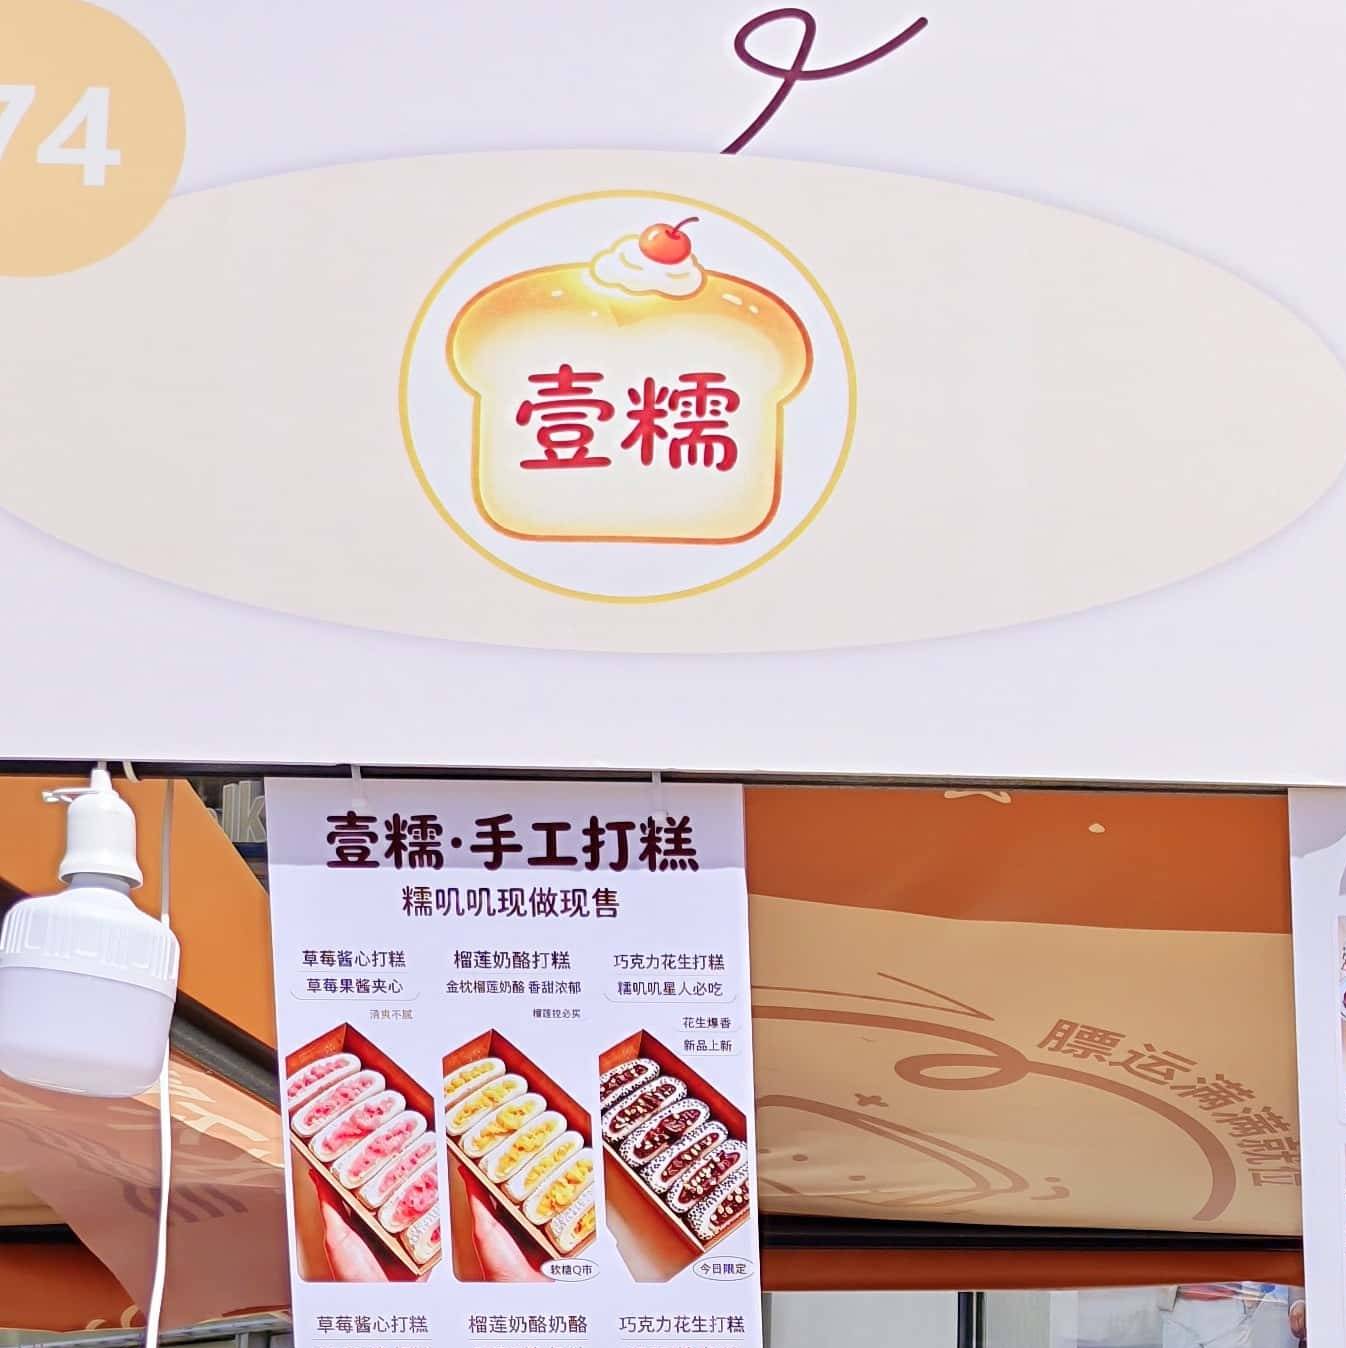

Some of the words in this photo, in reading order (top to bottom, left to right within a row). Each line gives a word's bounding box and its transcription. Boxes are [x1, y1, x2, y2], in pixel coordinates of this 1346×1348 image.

[515, 364, 741, 472] 壹糯
[326, 811, 699, 872] 壹糯·手工打糕
[401, 886, 621, 919] 糯叽叽现做现售
[301, 950, 406, 969] 草莓酱心打糕
[454, 950, 571, 970] 榴莲奶酪打糕
[613, 953, 725, 971] 巧克力花生打糕
[306, 978, 404, 994] 草莓果酱夹心
[618, 981, 723, 997] 糯叽叽星人必吃
[683, 1016, 732, 1030] 花生爆香
[684, 1039, 732, 1052] 新品上新
[700, 1262, 747, 1277] 今日限定
[316, 1315, 429, 1334] 草莓酱心打糕
[468, 1315, 588, 1334] 榴莲奶酪奶酪
[618, 1315, 745, 1334] 巧克力花生打糕
